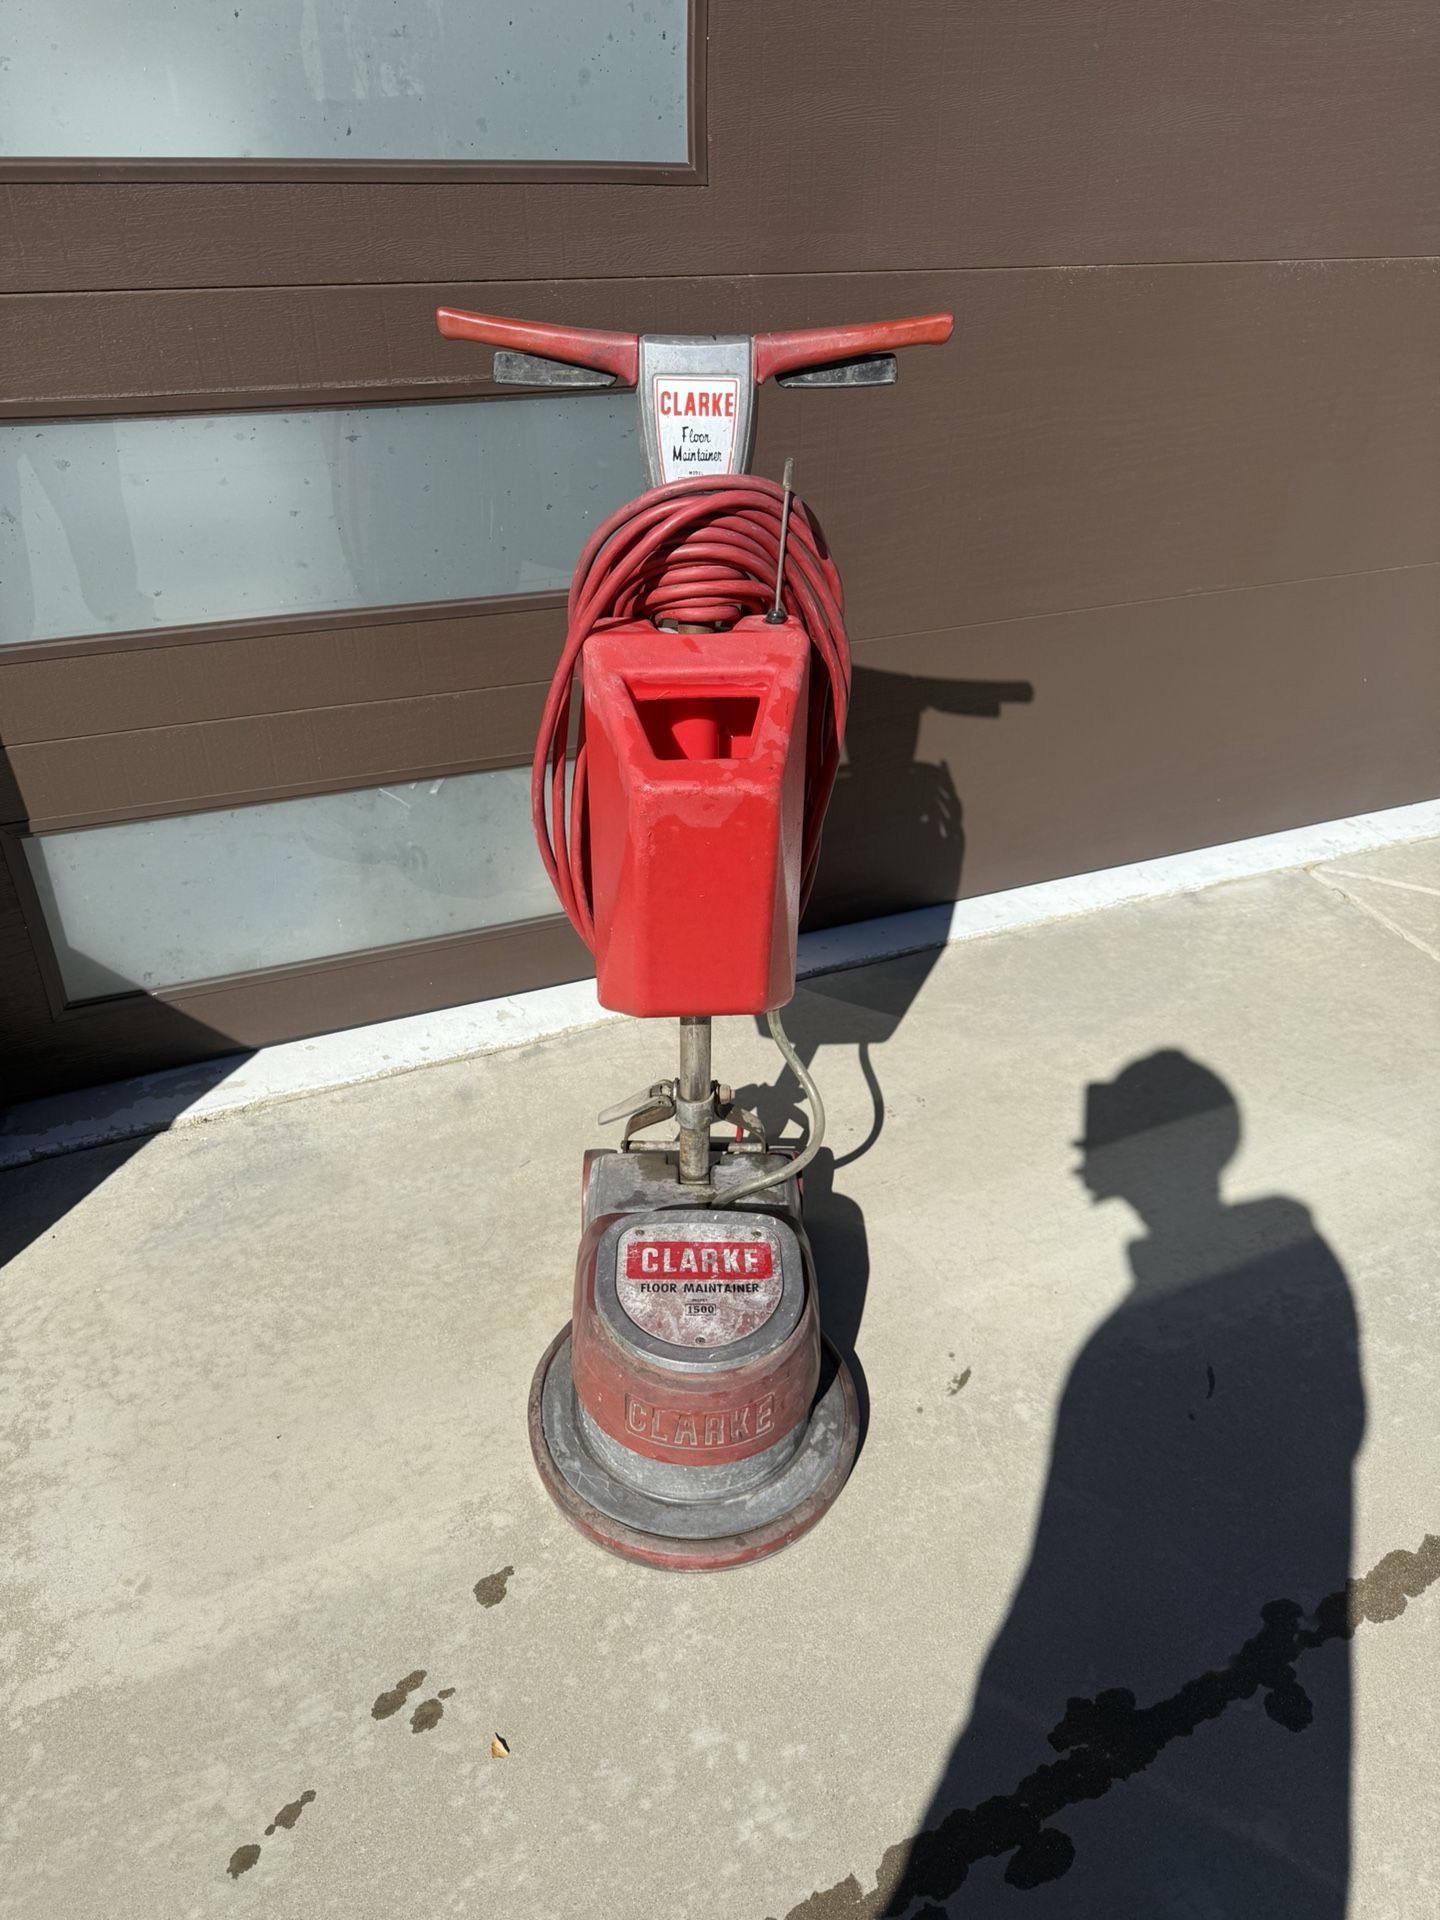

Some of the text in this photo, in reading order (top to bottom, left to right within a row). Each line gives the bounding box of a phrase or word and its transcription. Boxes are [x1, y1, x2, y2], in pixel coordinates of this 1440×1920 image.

[660, 391, 734, 417] CLARKE
[681, 426, 711, 443] Floor
[673, 445, 722, 462] Maintainer
[641, 1247, 759, 1273] CLARKE
[640, 1283, 759, 1293] FLOOR MAINTAINER
[688, 1305, 714, 1314] 1500
[628, 1396, 775, 1446] CLARKE
